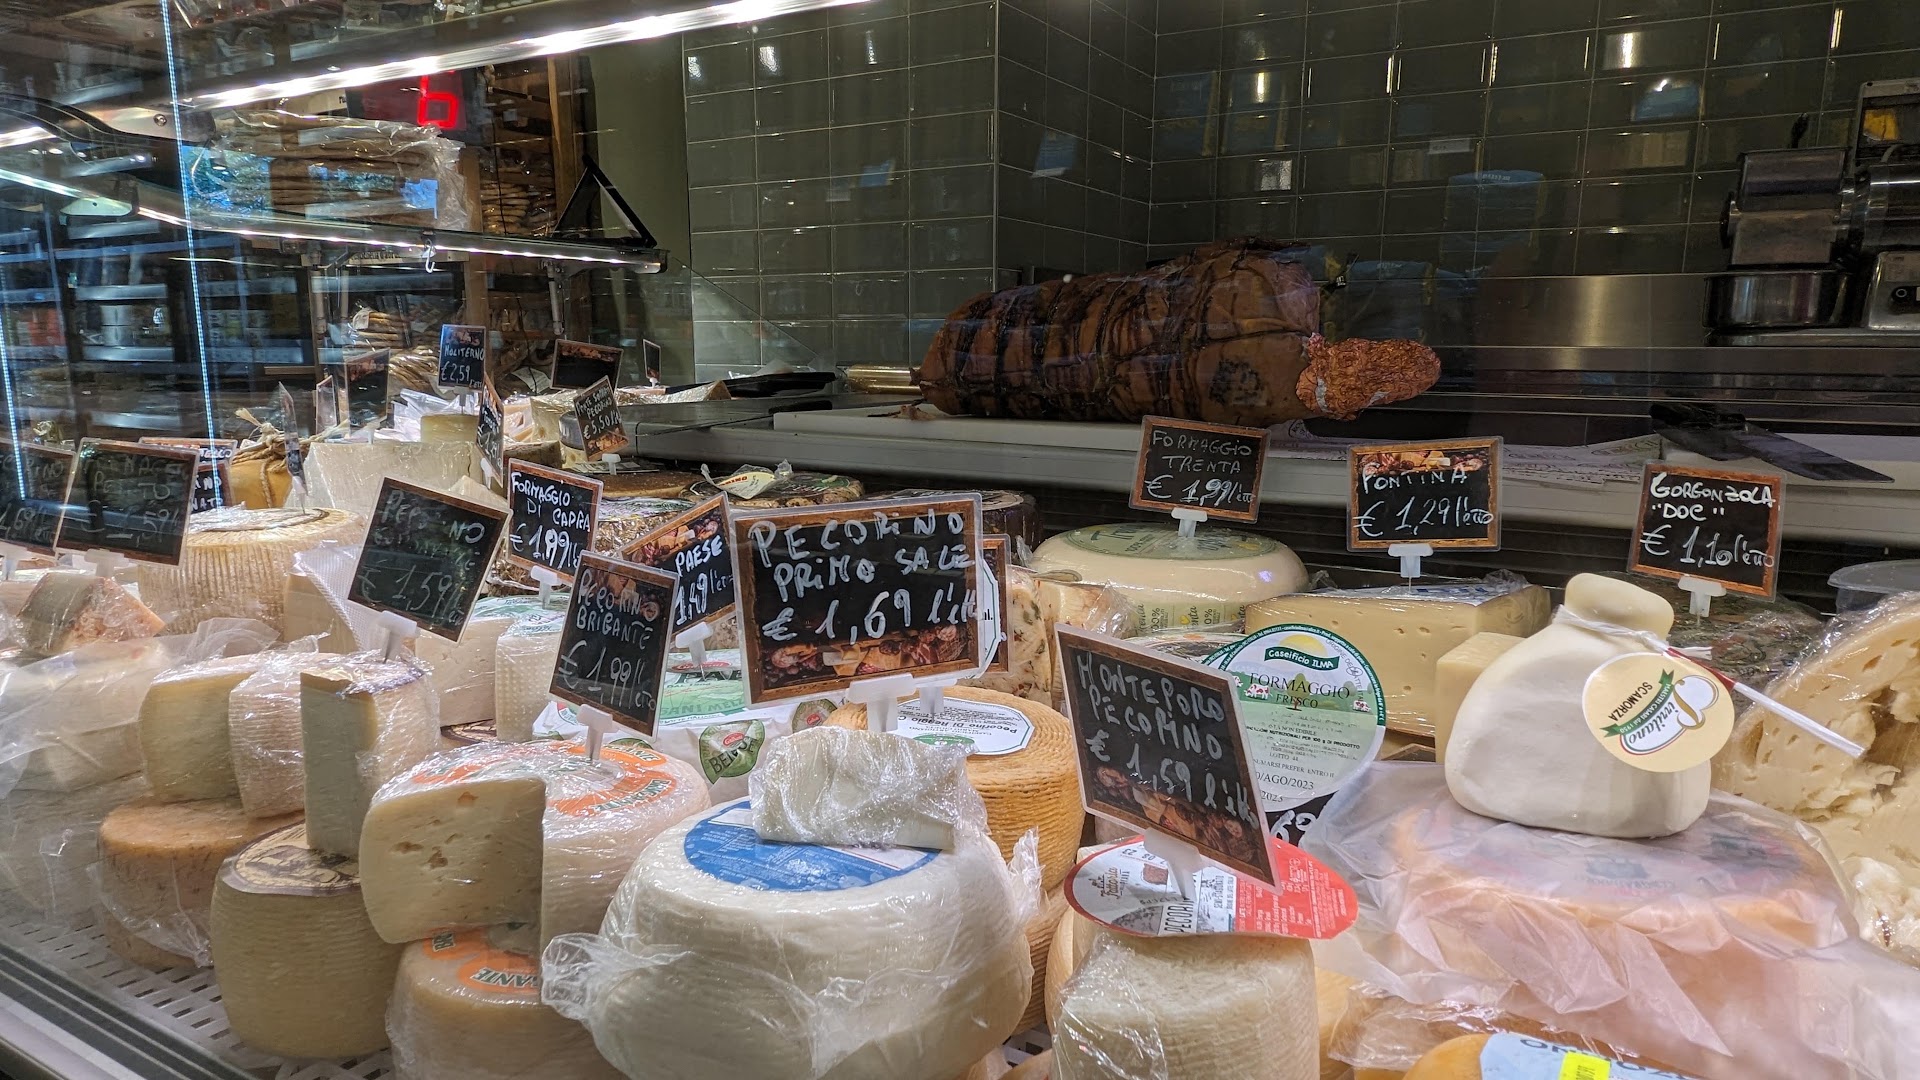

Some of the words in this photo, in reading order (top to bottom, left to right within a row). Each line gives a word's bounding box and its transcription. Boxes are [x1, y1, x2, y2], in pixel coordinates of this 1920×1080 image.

[441, 360, 450, 381] €
[583, 424, 591, 440] €
[1152, 429, 1252, 456] FORMAGGIO
[1161, 455, 1241, 474] TRENTA
[1361, 461, 1468, 495] FONTINA
[511, 472, 571, 507] FORMAGGIO
[1144, 474, 1174, 499] €
[1650, 471, 1776, 508] GORGONZOLA
[527, 497, 541, 518] DI
[552, 508, 591, 533] CAPRA
[1353, 500, 1385, 538] €
[509, 523, 527, 553] €
[1640, 524, 1673, 556] €
[675, 534, 723, 577] PAESE
[894, 543, 976, 576] SALE
[762, 607, 798, 641] €
[814, 588, 912, 646] 1,69
[1190, 605, 1200, 629] enta
[1203, 608, 1213, 625] 0%
[558, 639, 588, 690] €
[1268, 649, 1310, 666] Caseificio
[1311, 658, 1334, 669] ILMA
[1250, 672, 1351, 700] FORMAGGIO
[1275, 693, 1319, 709] FRESCO
[1608, 681, 1653, 722] SCAMORZA
[911, 717, 949, 727] Reggio
[968, 723, 1018, 734] Pecorino
[1085, 729, 1111, 763] €
[470, 966, 540, 988] ANTE
